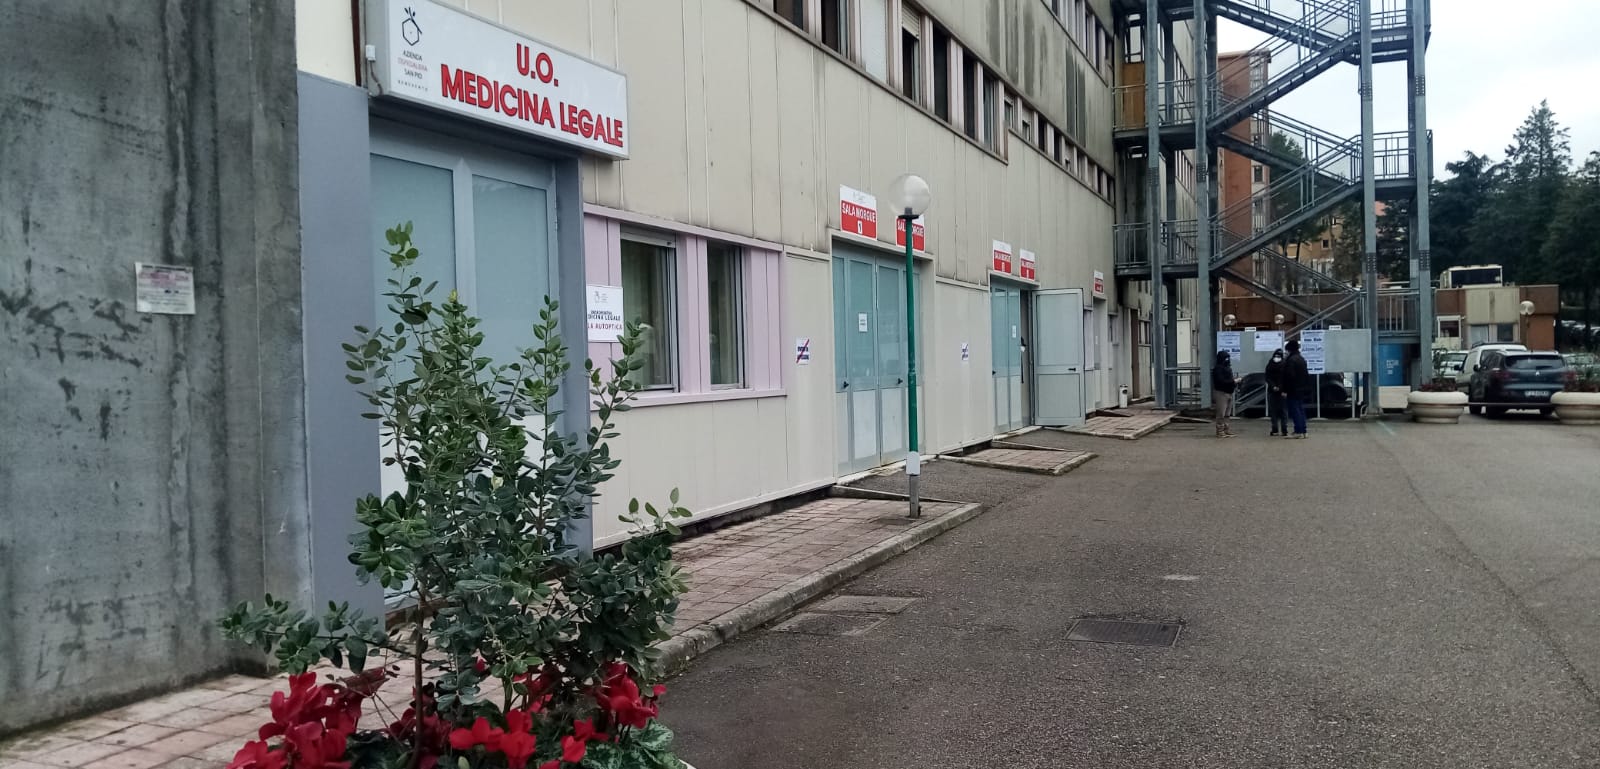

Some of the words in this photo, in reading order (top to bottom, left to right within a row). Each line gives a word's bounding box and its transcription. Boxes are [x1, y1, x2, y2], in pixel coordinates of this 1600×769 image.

[516, 43, 559, 87] U.O.
[440, 63, 556, 128] MEDICINA
[559, 102, 624, 147] LEGALE
